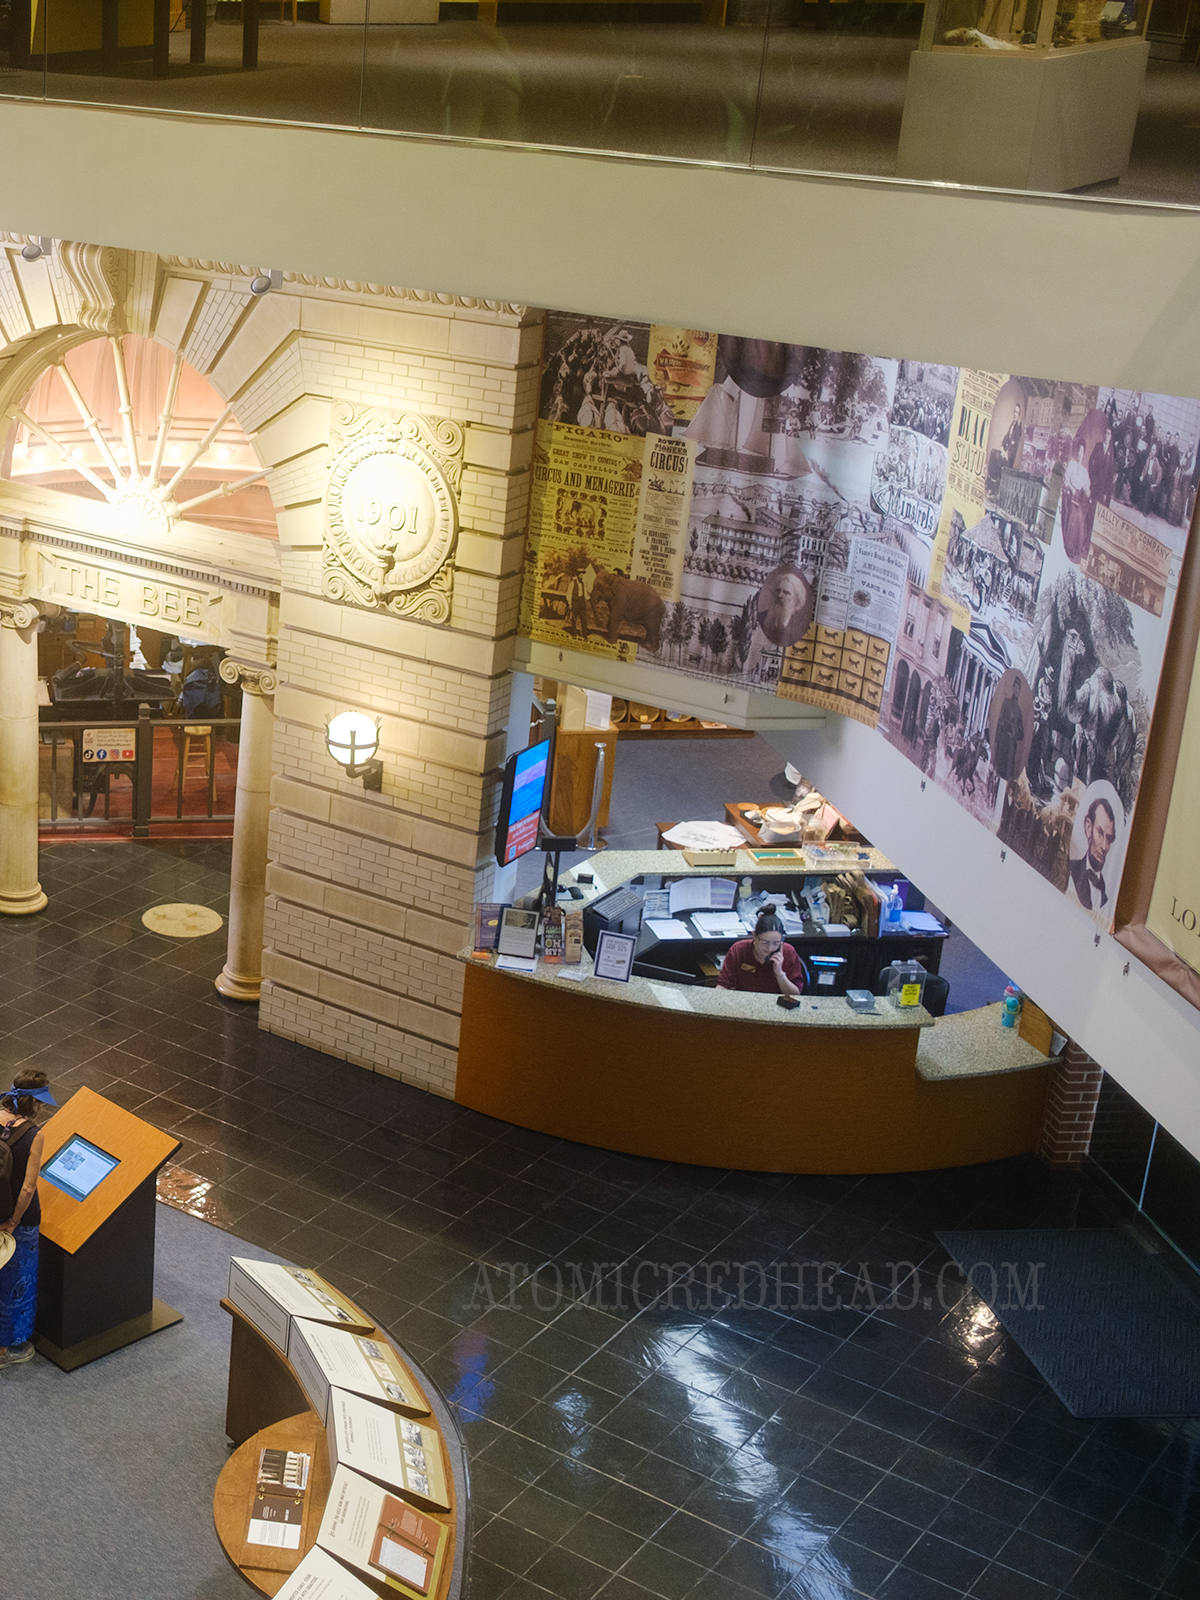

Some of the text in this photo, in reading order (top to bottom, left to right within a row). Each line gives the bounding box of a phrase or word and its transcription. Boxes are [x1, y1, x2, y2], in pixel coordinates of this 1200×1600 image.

[563, 435, 588, 444] Dramatic
[552, 448, 569, 458] GREAT
[572, 452, 588, 460] SHOW
[597, 456, 621, 468] COMING!
[554, 458, 569, 466] DAN
[650, 451, 689, 474] CIRCUS!
[535, 465, 635, 498] CIRCUS AND MENAGERIE
[356, 495, 419, 535] 1901
[1096, 504, 1120, 527] VALLEY
[1120, 522, 1138, 535] FRUIT
[1138, 533, 1170, 561] COMPANY
[59, 565, 202, 627] THE BEE
[861, 580, 881, 593] VANCE
[545, 938, 561, 949] OH
